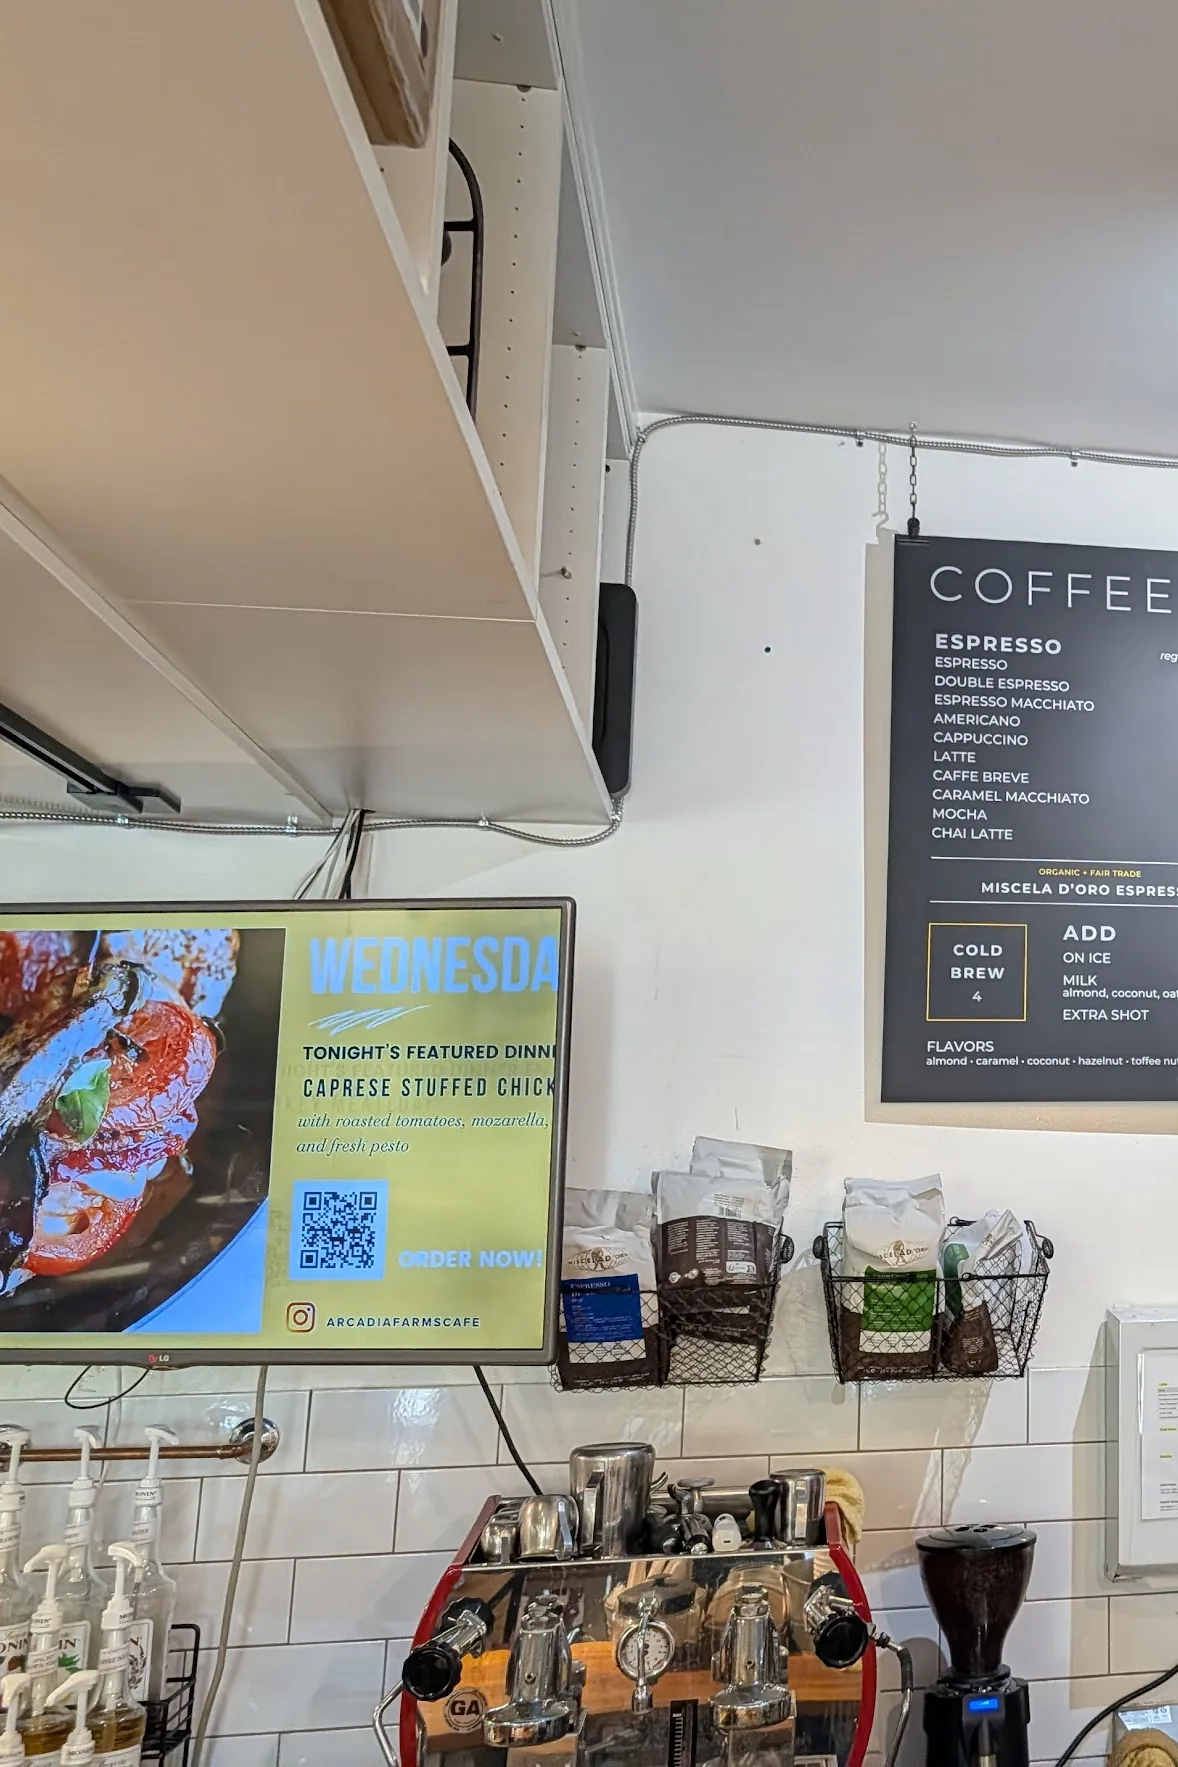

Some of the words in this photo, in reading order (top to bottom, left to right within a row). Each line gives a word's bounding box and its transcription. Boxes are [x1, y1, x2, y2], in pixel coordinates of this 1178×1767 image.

[936, 634, 1061, 654] ESPRESSO
[936, 656, 1007, 670] ESPRESSO
[935, 676, 994, 688] DOUBLE
[998, 678, 1069, 692] ESPRESSO
[935, 694, 1007, 707] ESPRESSO
[1012, 698, 1094, 711] MACCHIATO
[934, 713, 1020, 726] AMERICANO
[934, 732, 1028, 746] CAPPUCCINO
[934, 751, 976, 762] LATTE
[933, 770, 978, 782] CAFFE
[983, 772, 1029, 783] BREVE
[933, 789, 1002, 801] CARAMEL
[1006, 792, 1089, 804] MACCHIATO
[933, 808, 987, 820] MOCHA
[932, 827, 966, 838] CHAI
[972, 829, 1012, 840] LATTE
[1039, 868, 1080, 876] ORGANIC
[982, 882, 1052, 894] MISCELA
[1059, 884, 1110, 895] D'ORO
[1063, 926, 1116, 941] ADD
[954, 944, 1002, 956] COLD
[1063, 952, 1084, 963] ON
[1090, 953, 1110, 963] ICE
[951, 968, 1004, 979] BREW
[1064, 975, 1097, 986] MILK
[972, 991, 982, 1002] 4
[1063, 988, 1108, 999] almond,
[1112, 990, 1160, 999] coconut,
[1064, 1010, 1108, 1020] EXTRA
[1112, 1010, 1149, 1020] SHOT
[303, 1044, 400, 1060] TONIGHT'S
[406, 1045, 499, 1059] FEATURED
[504, 1045, 555, 1059] DINN
[928, 1041, 994, 1052] FLAVORS
[926, 1056, 967, 1065] almond
[976, 1056, 1018, 1065] caramel
[1027, 1057, 1070, 1065] coconut
[1079, 1056, 1123, 1065] hazelnut
[1131, 1056, 1161, 1065] toffee
[303, 1079, 391, 1097] CAPRESE
[401, 1078, 487, 1097] STUFFED
[298, 1113, 330, 1128] with
[335, 1113, 390, 1128] roasted
[395, 1114, 466, 1129] tomatoes,
[471, 1112, 549, 1129] mozarella,
[297, 1138, 326, 1153] and
[327, 1137, 365, 1156] fresh
[369, 1138, 409, 1156] pesto
[398, 1250, 472, 1268] ORDER
[479, 1250, 543, 1268] NOW!
[570, 1281, 611, 1289] ESPRESSO
[327, 1317, 480, 1327] ARCADIAFARMSCAFE
[451, 1700, 480, 1715] GA
